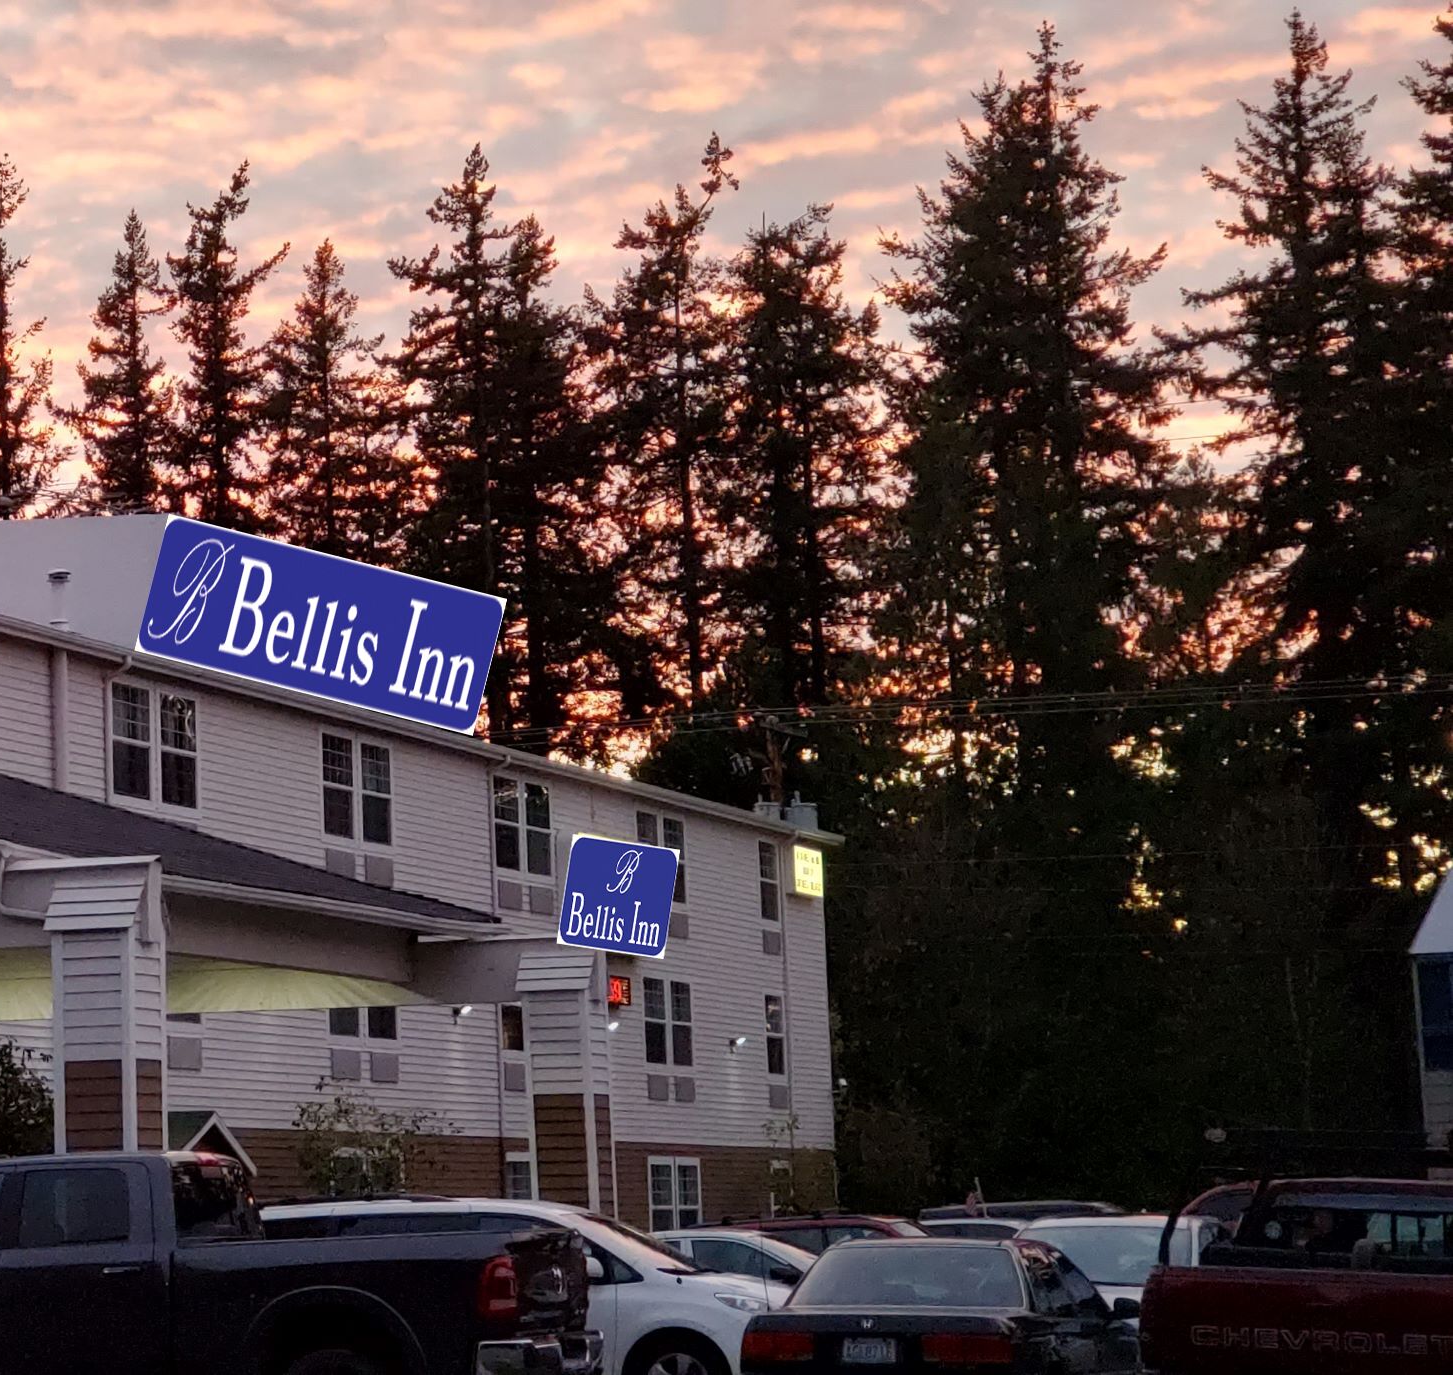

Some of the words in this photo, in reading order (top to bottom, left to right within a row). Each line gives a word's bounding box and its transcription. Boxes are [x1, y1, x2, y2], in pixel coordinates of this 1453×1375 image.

[218, 555, 379, 687] Bellis
[388, 598, 476, 712] Inn
[566, 891, 625, 943] Bellis
[628, 900, 660, 947] Inn
